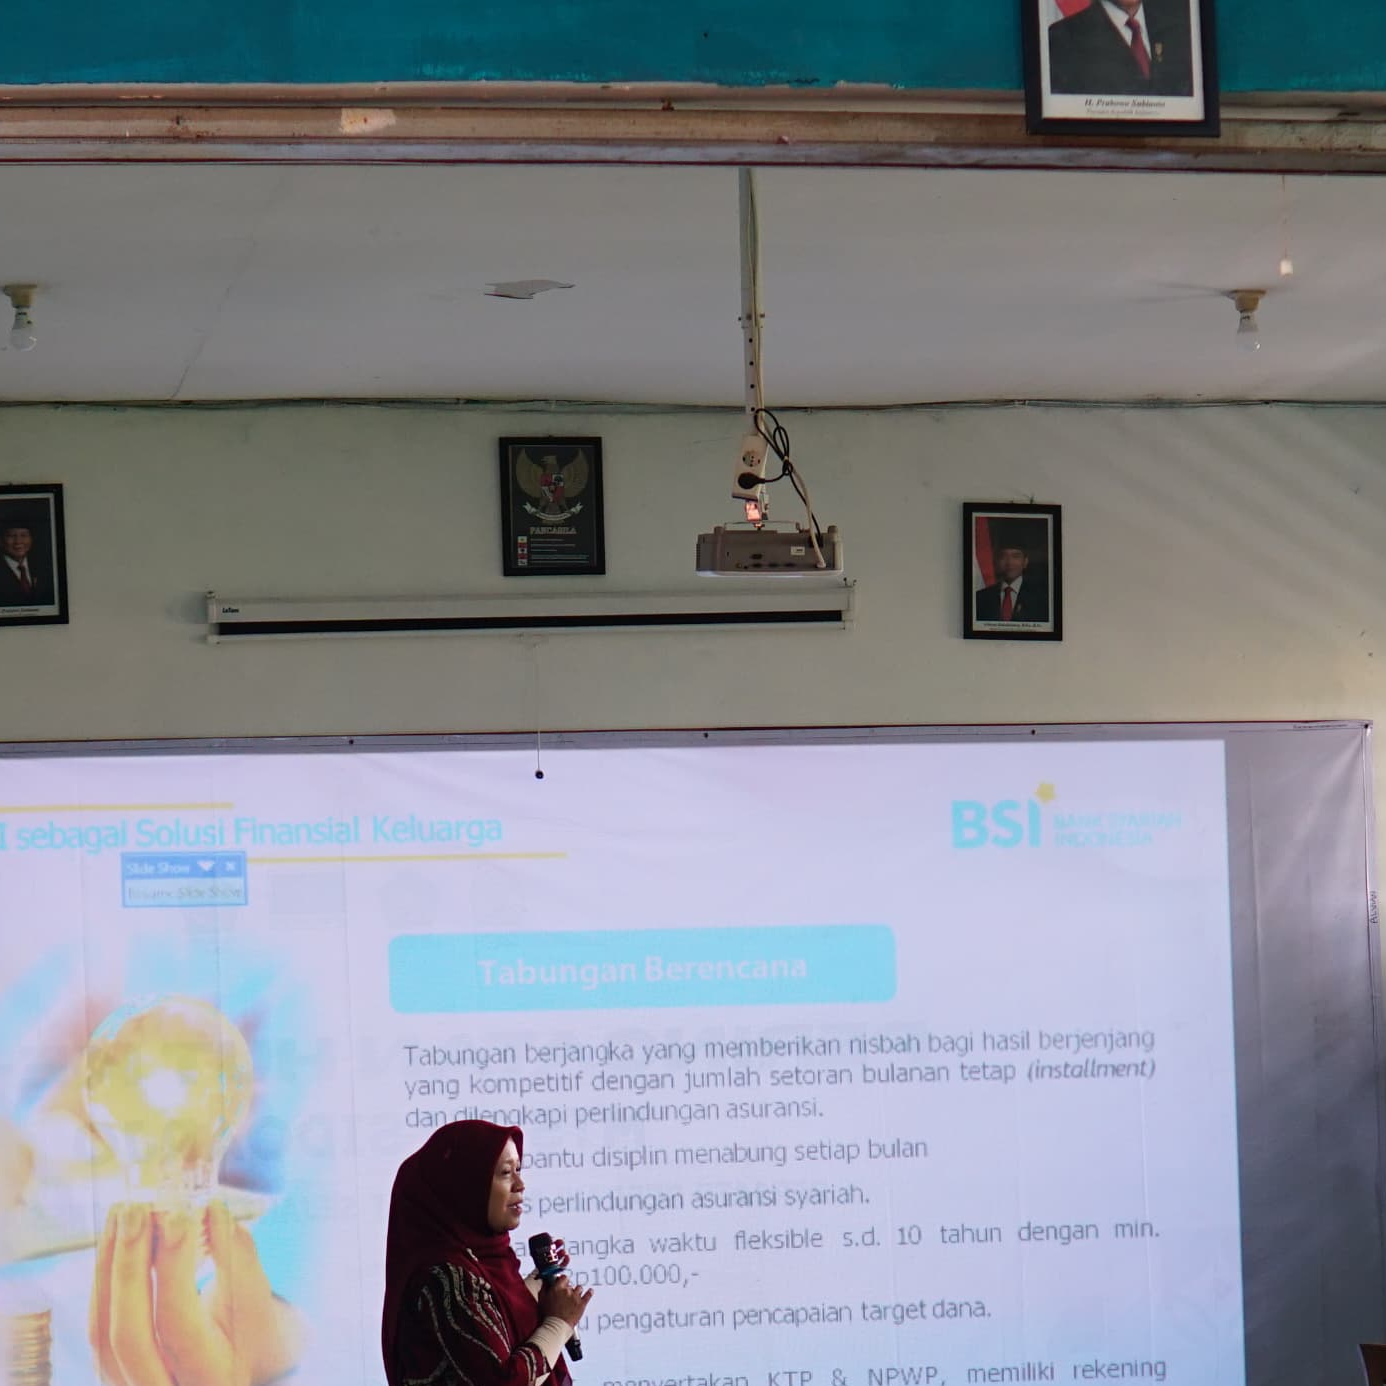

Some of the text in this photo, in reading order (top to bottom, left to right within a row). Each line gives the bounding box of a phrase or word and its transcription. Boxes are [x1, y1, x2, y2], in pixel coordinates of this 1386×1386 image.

[17, 821, 128, 855] sebagai
[135, 817, 225, 848] Solusi
[233, 815, 360, 846] Finansial
[372, 813, 503, 848] Keluarga
[951, 799, 1043, 849] BSI
[476, 955, 808, 991] Tabungan Berencana
[404, 1029, 1156, 1067] Tabungan berjangka yang memberikan nisbah bagi hasil berjenjang
[404, 1058, 1157, 1101] yang kompetitif dengan jumlah setoran bulanan tetap (installment)
[405, 1107, 447, 1128] dan
[575, 1102, 719, 1128] perlindungan
[726, 1098, 824, 1121] asuransi.
[592, 1146, 667, 1170] disiplin
[674, 1143, 786, 1168] menabung
[794, 1141, 860, 1164] setiap
[868, 1138, 928, 1160] bulan
[539, 1190, 684, 1217] perlindungan
[691, 1187, 777, 1209] asuransi
[783, 1184, 870, 1209] syariah.
[564, 1219, 1161, 1259] angka waktu fleksible s.d. 10 tahun dengan min.
[597, 1308, 725, 1334] pengaturan
[733, 1303, 853, 1331] pencapaian
[860, 1300, 928, 1325] target
[932, 1298, 992, 1319] dana.
[967, 1361, 1055, 1384] memiliki
[1072, 1358, 1167, 1382] rekening
